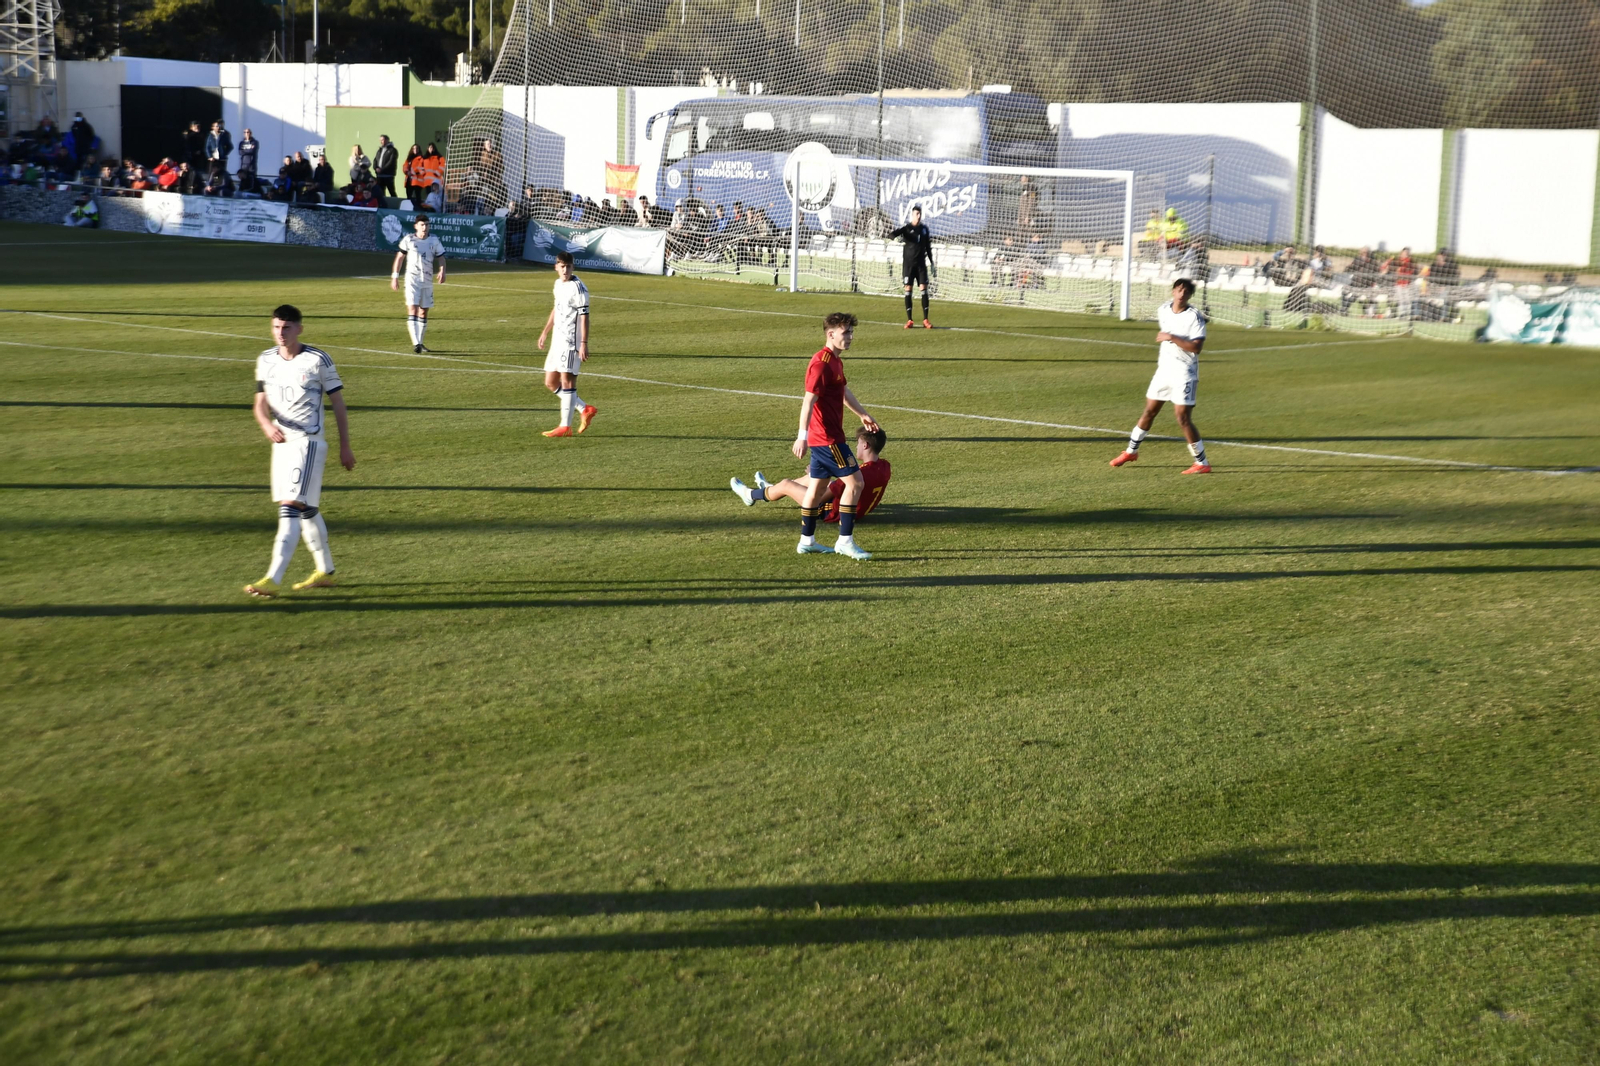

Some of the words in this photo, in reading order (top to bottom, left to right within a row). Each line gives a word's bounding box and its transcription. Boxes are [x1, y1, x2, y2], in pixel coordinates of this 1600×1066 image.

[712, 160, 752, 170] JUVENTUD
[694, 168, 754, 179] TORREMOLINOS
[756, 170, 771, 180] C.F.
[880, 161, 951, 204] ¡VAMOS
[443, 218, 474, 226] MARISCOS
[279, 386, 294, 402] 10
[864, 486, 883, 515] 7
